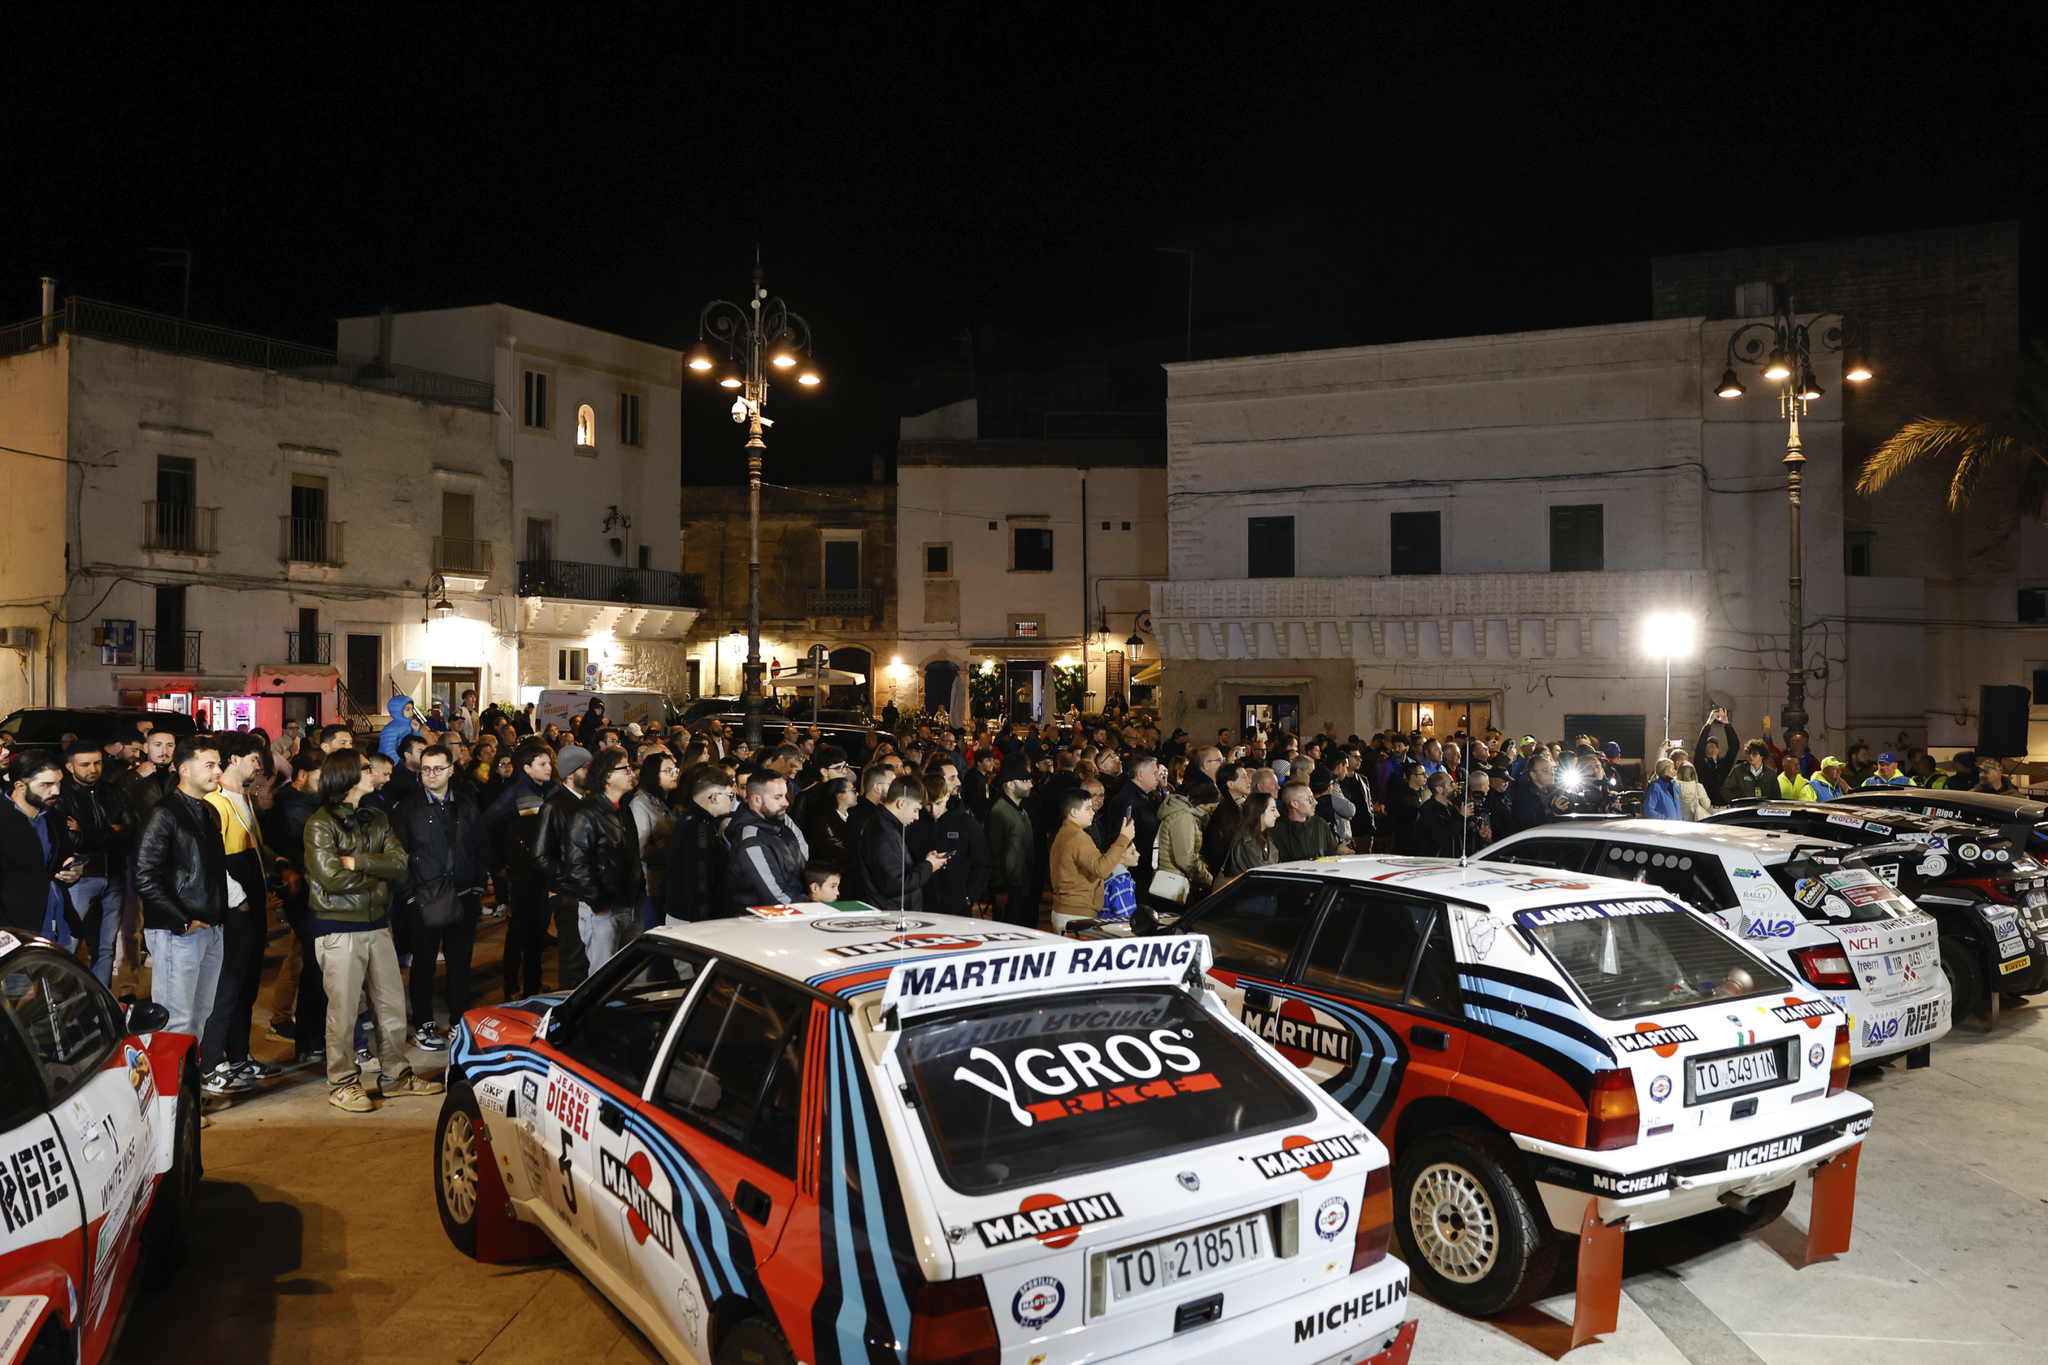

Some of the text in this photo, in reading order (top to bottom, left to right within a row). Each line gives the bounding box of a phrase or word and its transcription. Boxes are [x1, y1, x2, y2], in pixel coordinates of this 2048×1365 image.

[1936, 808, 1964, 819] Rigo J.
[1743, 891, 1768, 900] RALLY
[1526, 900, 1675, 927] LANCIA MARTINI
[1751, 910, 1798, 920] GRUPPO
[1877, 917, 1908, 931] WHITE
[1849, 936, 1879, 951] NCH
[900, 940, 1191, 997] MARTINI RACING
[1774, 1001, 1835, 1023] MARTINI
[1870, 1010, 1899, 1021] GRUPPO
[1244, 1010, 1349, 1061] MARTINI
[1618, 1026, 1695, 1052] MARTINI
[1697, 1064, 1720, 1091] TO
[1727, 1051, 1777, 1084] 54911N
[479, 1095, 504, 1113] BILSTEIN
[482, 1083, 503, 1097] SKF
[556, 1074, 590, 1105] JEANS
[546, 1081, 590, 1141] DIESEL
[1258, 1137, 1357, 1178] MARTINI
[1726, 1135, 1803, 1171] MICHELIN
[101, 1160, 122, 1211] WHITE
[558, 1127, 578, 1215] 5
[1593, 1172, 1669, 1194] MICHELIN
[602, 1153, 671, 1251] MARTINI
[981, 1194, 1118, 1245] MARTINI
[1117, 1250, 1156, 1292] TO
[1174, 1219, 1258, 1278] 21851T
[1021, 1294, 1057, 1311] MARTINI
[1293, 1276, 1409, 1345] MICHELIN
